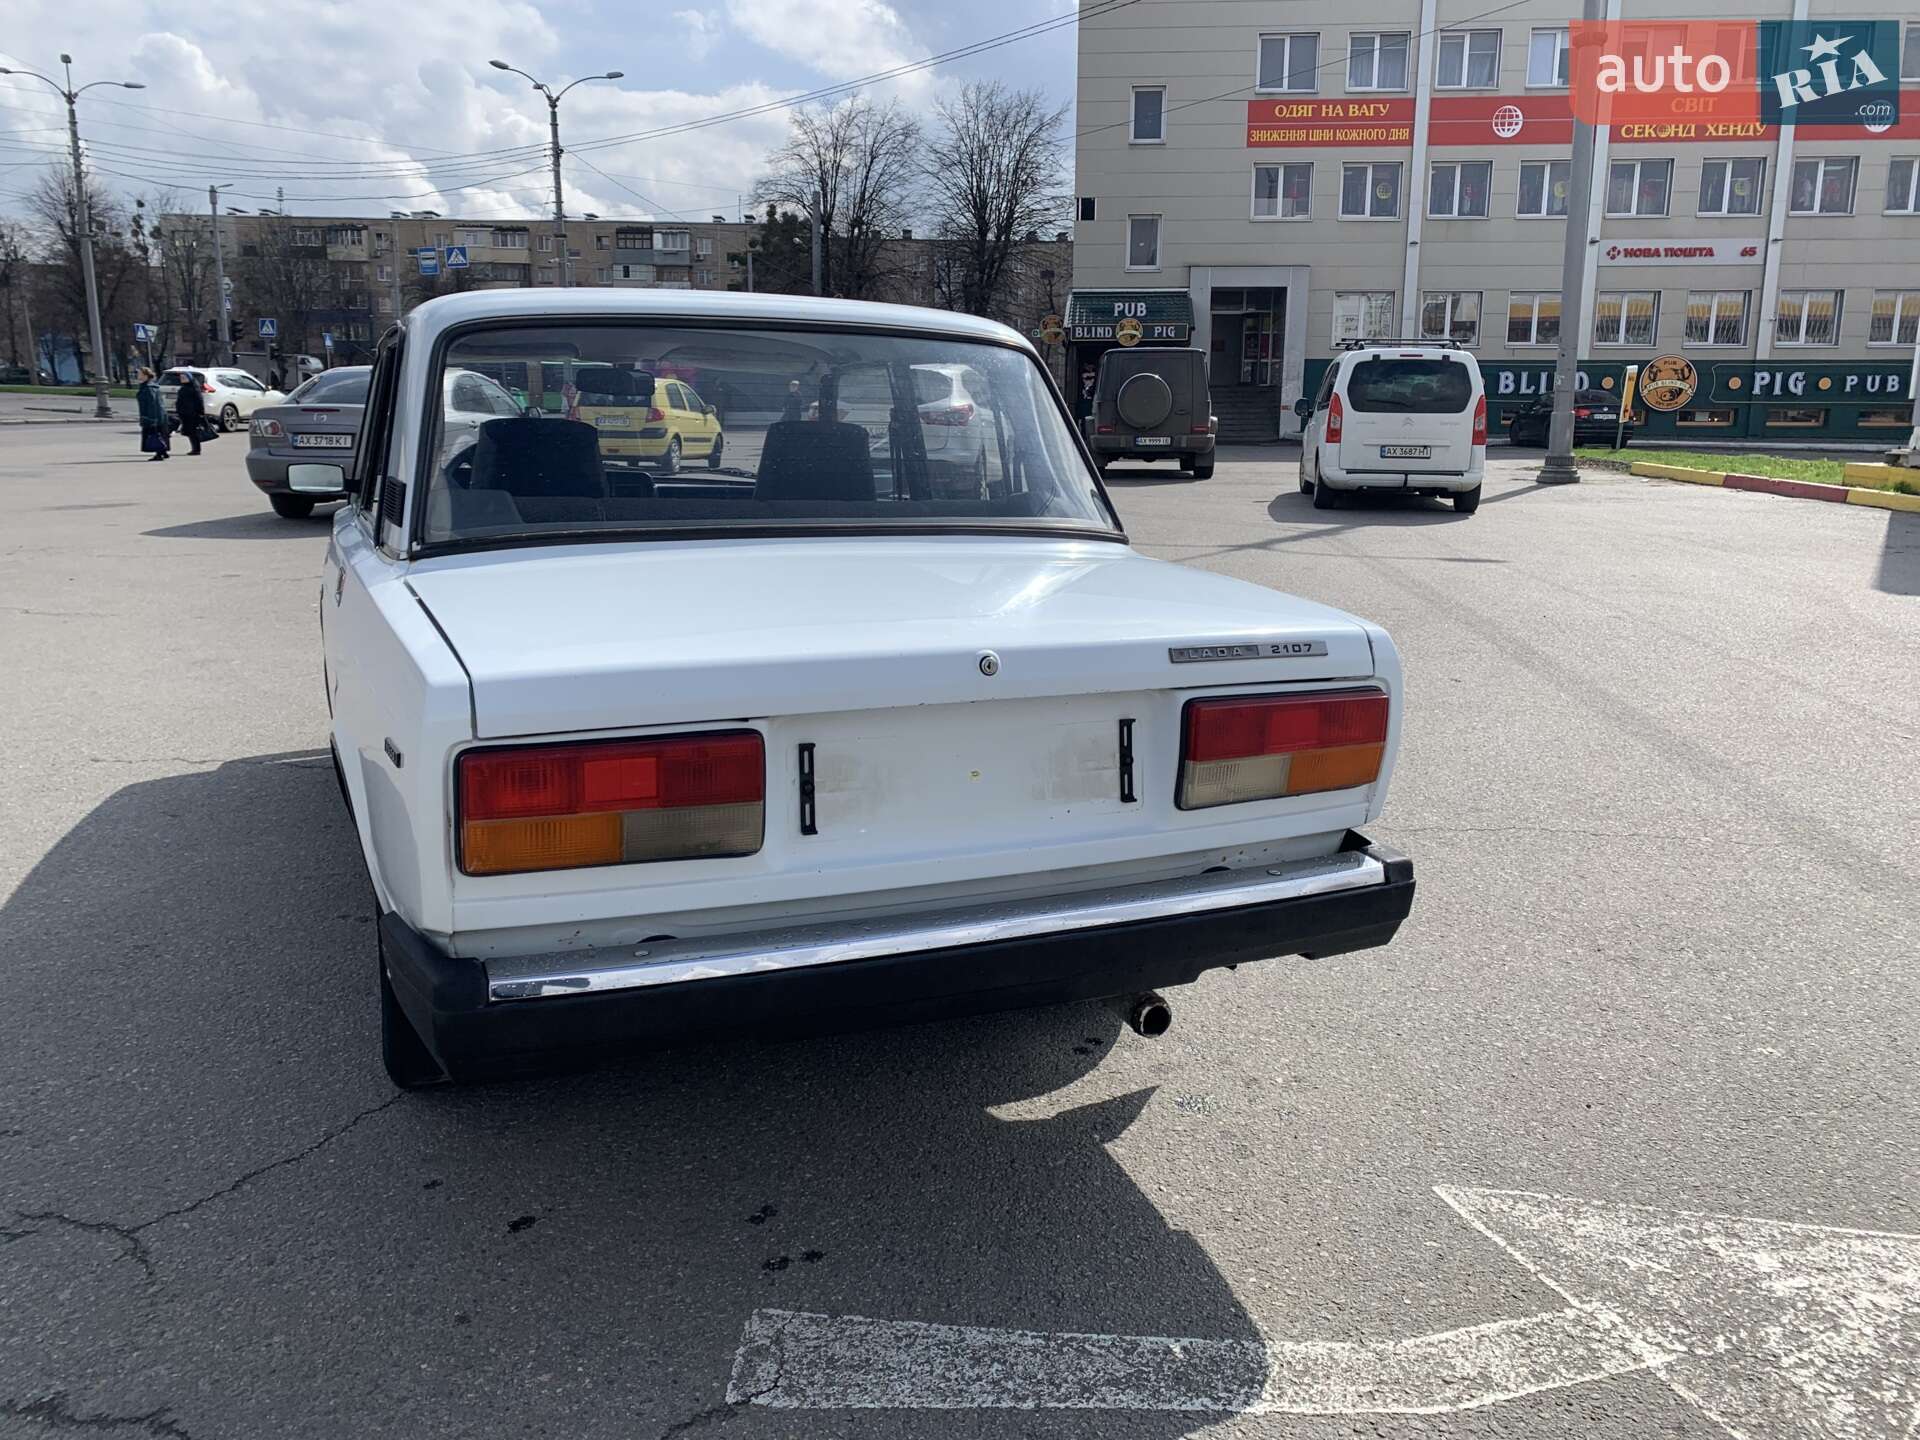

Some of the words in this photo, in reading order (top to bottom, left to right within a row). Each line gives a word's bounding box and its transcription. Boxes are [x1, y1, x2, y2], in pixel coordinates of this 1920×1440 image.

[1274, 104, 1318, 118] ОДЯГ
[1321, 104, 1345, 117] НА
[1348, 103, 1390, 117] ВАГУ
[1250, 129, 1307, 142] ЗНИЖЕННЯ
[1336, 128, 1386, 141] КОЖНОГО
[1388, 128, 1410, 141] ДНЯ
[1705, 122, 1768, 137] ХЕНДУ
[1623, 247, 1661, 258] НОВА
[1664, 246, 1715, 258] ПОШТА
[1740, 246, 1758, 257] 65
[1113, 302, 1147, 317] PUB
[1075, 326, 1113, 338] BLIND
[1154, 326, 1176, 338] PIG
[1498, 370, 1590, 395] BLID
[1752, 371, 1806, 395] PIG
[1844, 374, 1900, 393] PUB
[298, 435, 311, 446] AX
[1188, 646, 1244, 659] LADA
[1271, 643, 1313, 655] 2107
